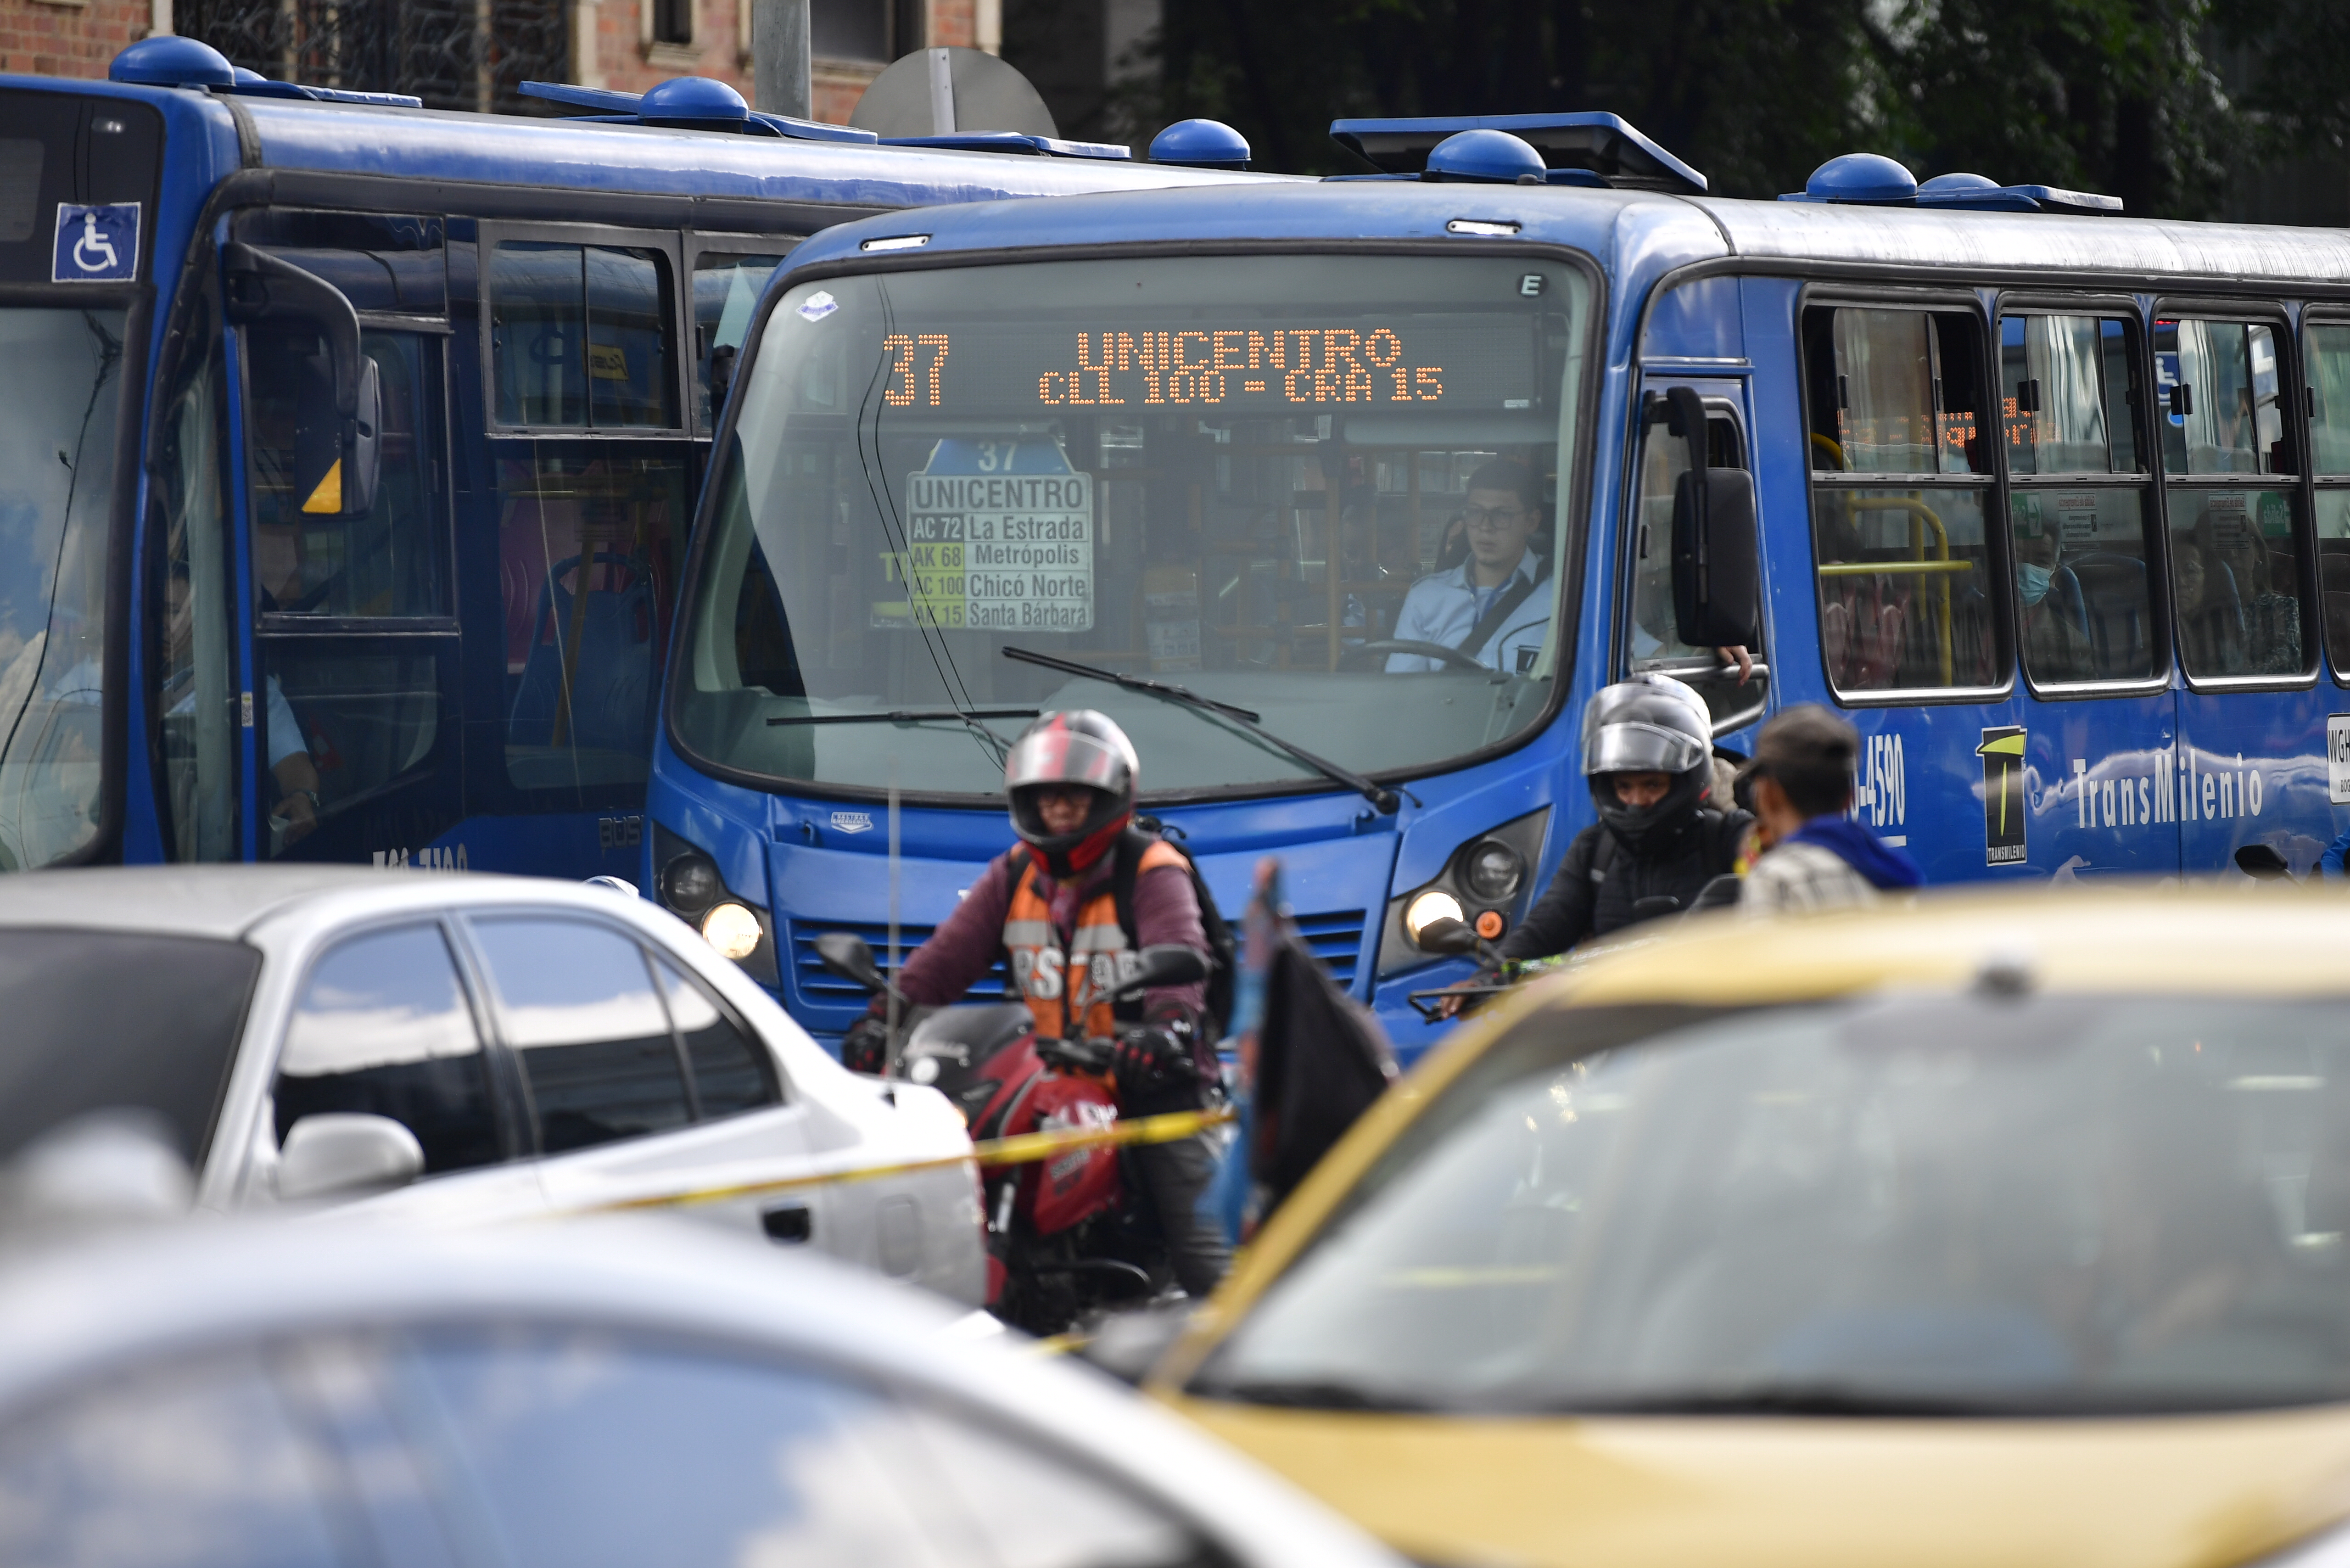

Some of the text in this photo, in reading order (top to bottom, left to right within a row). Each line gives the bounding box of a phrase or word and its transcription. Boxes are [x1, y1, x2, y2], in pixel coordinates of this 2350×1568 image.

[1520, 274, 1543, 297] E
[1077, 326, 1401, 370] UNICENTRO
[883, 334, 949, 406] 37
[1039, 366, 1443, 405] CLL 100 - CRA 15
[978, 442, 1017, 471] 37
[914, 478, 1082, 509] UNICENTRO
[913, 516, 1083, 540] AC 72 La Estrada
[914, 544, 1079, 568] AK 68 Metrópolis
[914, 573, 1085, 597] AC 100 Chicó Norte
[915, 602, 1085, 626] AK 15 Santa Bárbara
[2073, 748, 2262, 829] TransMilenio
[599, 814, 643, 848] BUS
[1988, 844, 2025, 862] TRANSMILENIO
